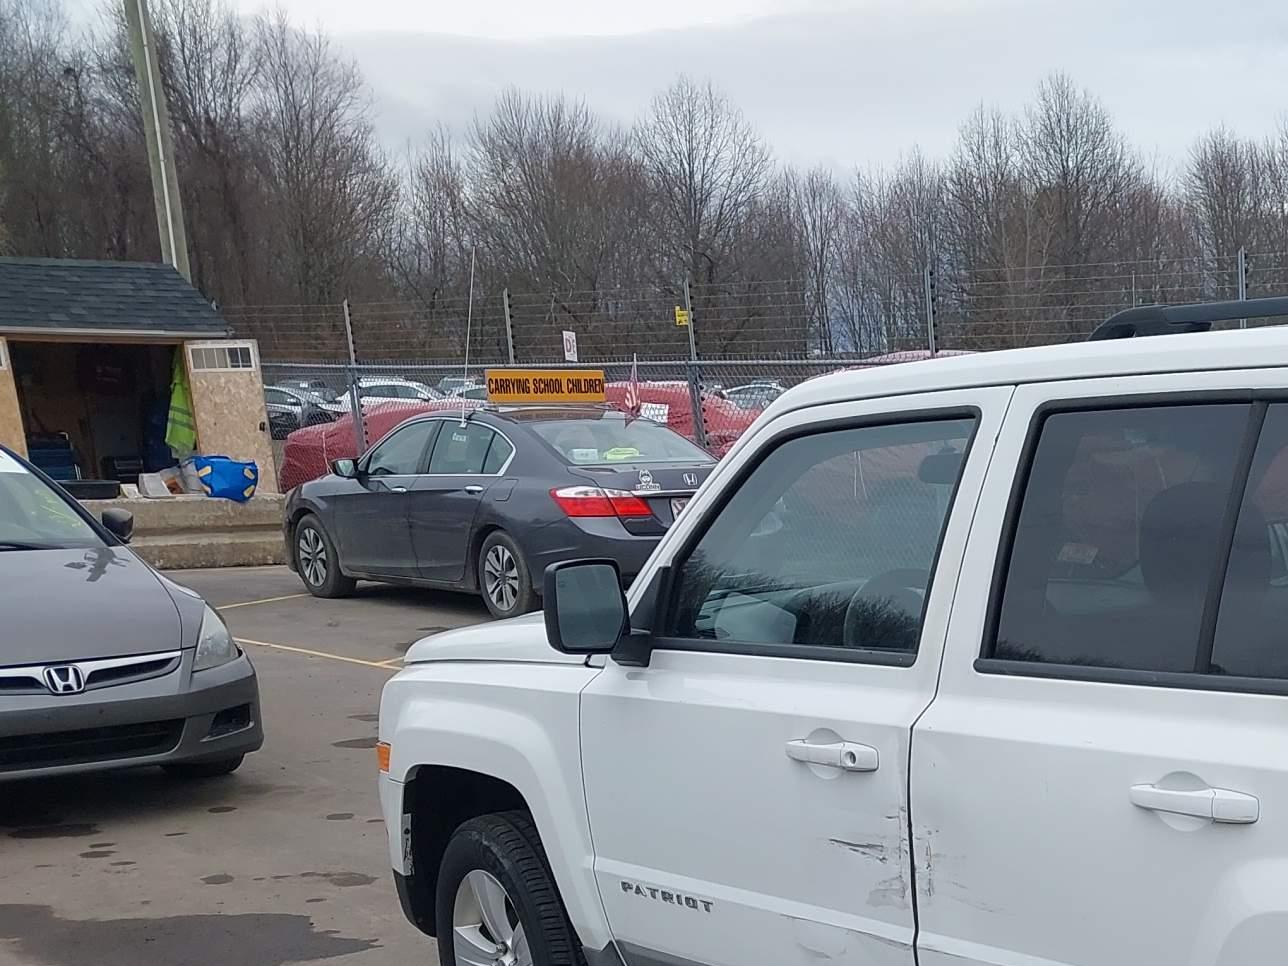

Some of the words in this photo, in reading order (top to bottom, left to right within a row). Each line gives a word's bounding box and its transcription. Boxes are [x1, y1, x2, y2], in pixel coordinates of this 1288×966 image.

[488, 377, 530, 395] CARRYING
[533, 378, 565, 394] SCHOOL
[566, 378, 605, 394] CHILDREN
[620, 881, 714, 913] PATRIOT
